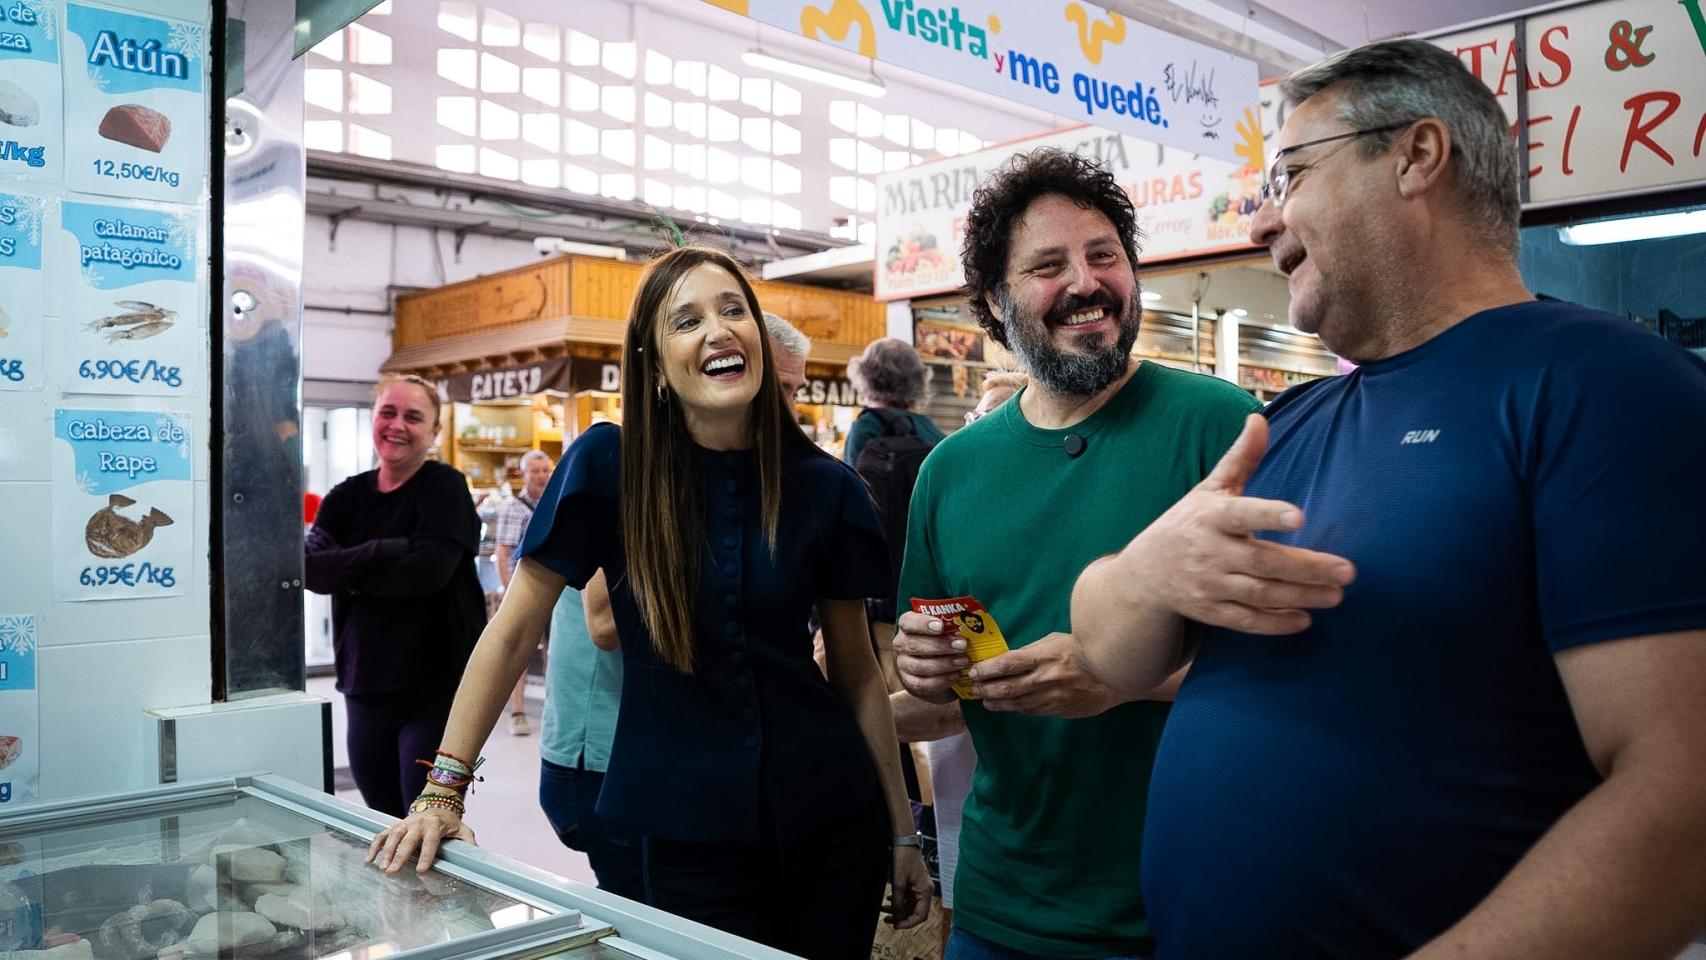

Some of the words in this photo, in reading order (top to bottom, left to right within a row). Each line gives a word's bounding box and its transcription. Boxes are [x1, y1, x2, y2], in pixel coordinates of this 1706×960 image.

[9, 1, 36, 25] de
[0, 32, 31, 52] za
[89, 30, 189, 80] Atún
[1604, 20, 1656, 72] &
[994, 52, 1005, 74] y
[1008, 49, 1061, 94] me
[1073, 72, 1169, 128] quedé.
[93, 159, 180, 188] 12,50€/kg
[93, 218, 169, 243] Calamar
[81, 241, 181, 269] patagónico
[78, 360, 182, 387] 6,90€/kg
[67, 419, 151, 443] Cabeza
[158, 420, 184, 443] de
[1400, 429, 1441, 445] RUN
[99, 451, 156, 479] Rape
[79, 562, 176, 588] 6,95€/kg
